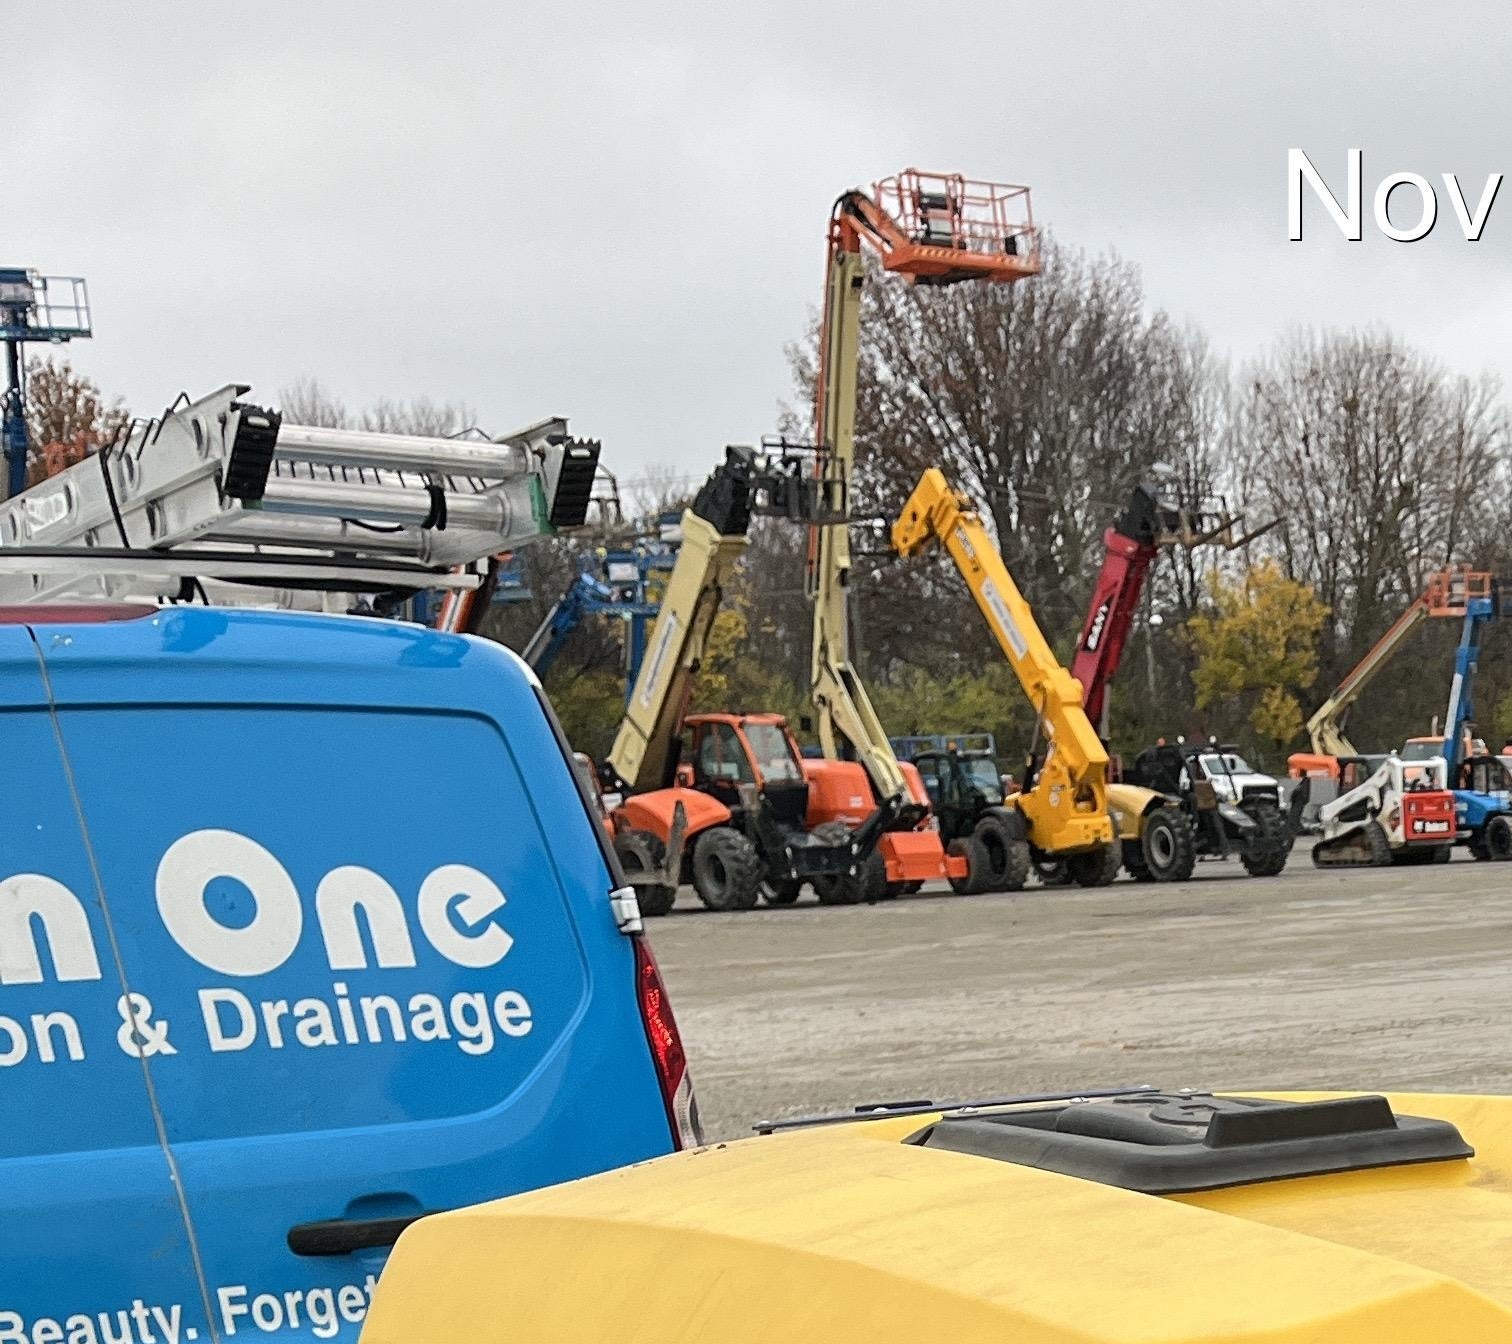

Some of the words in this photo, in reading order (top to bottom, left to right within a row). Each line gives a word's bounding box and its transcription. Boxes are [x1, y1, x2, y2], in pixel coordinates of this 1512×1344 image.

[155, 828, 514, 977] One
[117, 991, 179, 1058] &
[198, 982, 533, 1056] Drainage
